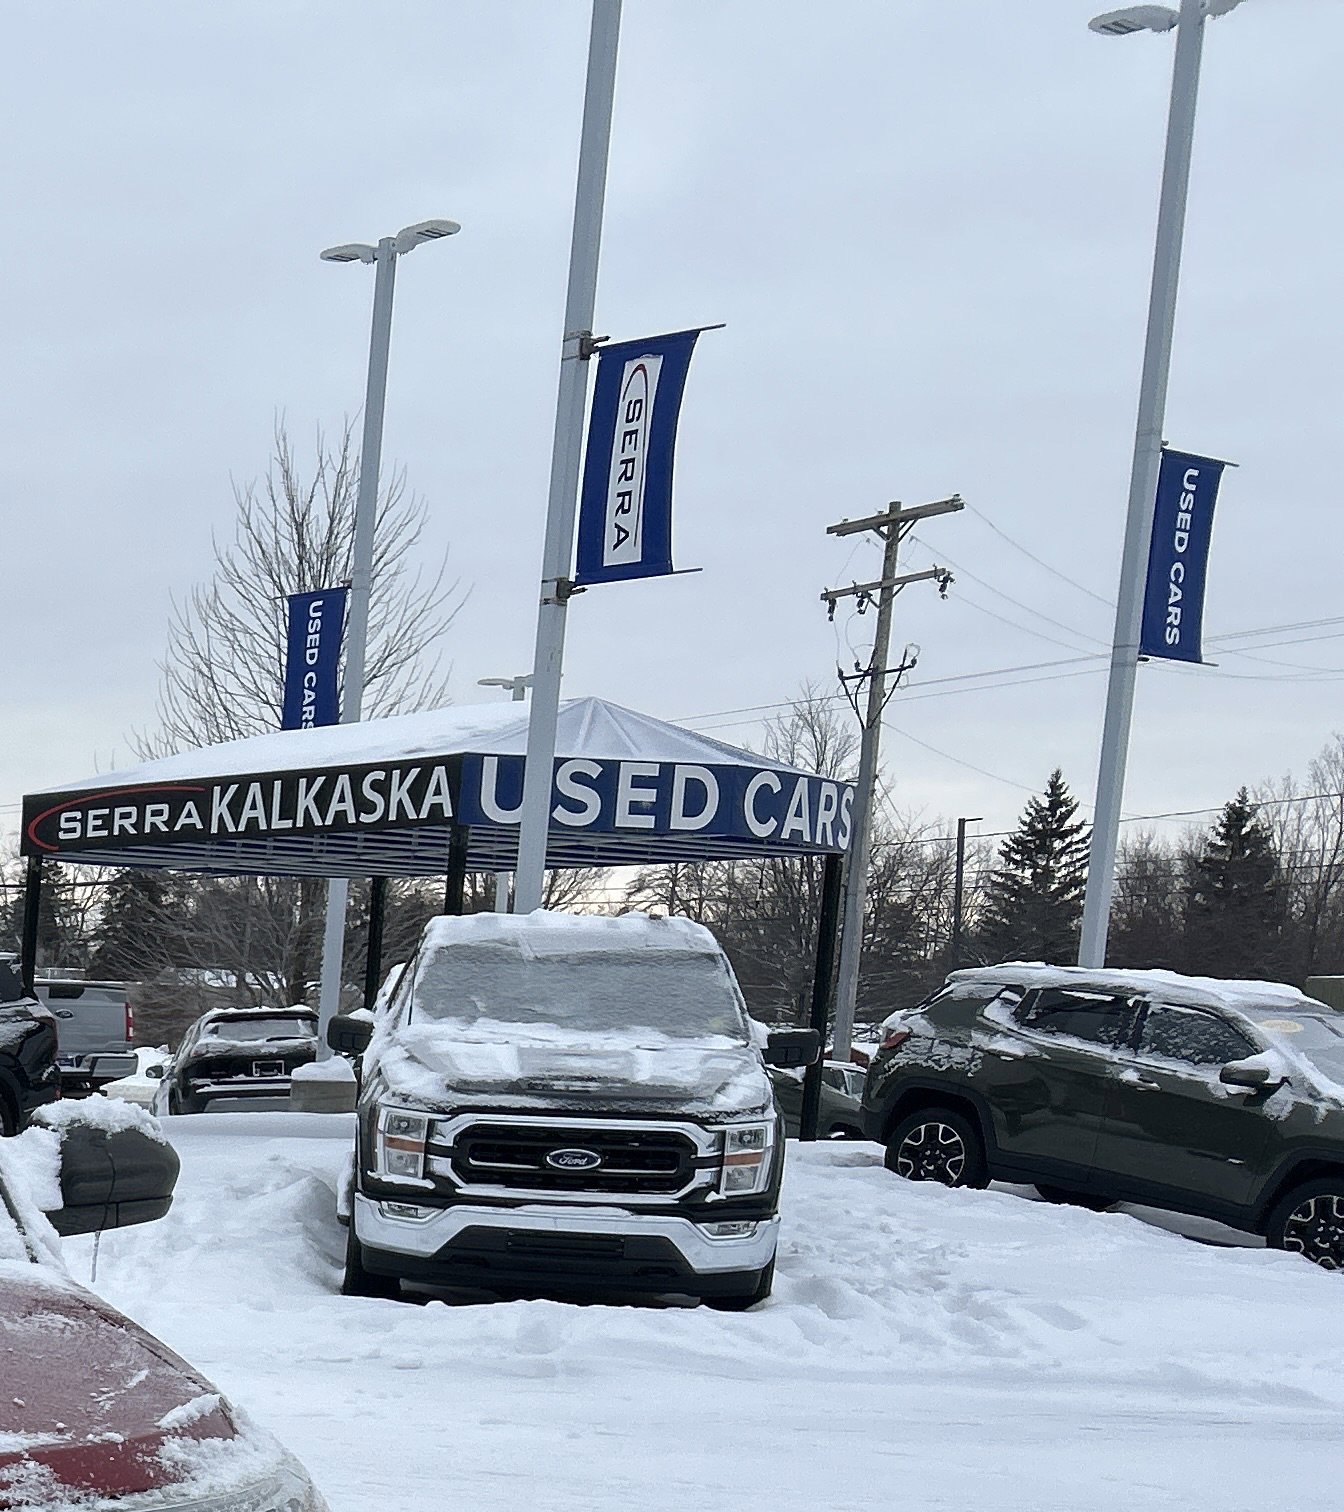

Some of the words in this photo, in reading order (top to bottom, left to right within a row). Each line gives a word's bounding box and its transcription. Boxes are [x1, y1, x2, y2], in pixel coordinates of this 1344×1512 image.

[612, 398, 643, 552] SERRA
[1174, 467, 1200, 554] USED
[305, 599, 324, 666] USED
[1165, 561, 1186, 646] CARS
[57, 800, 204, 840] SERRA
[210, 765, 454, 834] KALKASKA
[479, 756, 720, 832] USED
[743, 770, 855, 850] CARS
[559, 1152, 588, 1165] Ford
